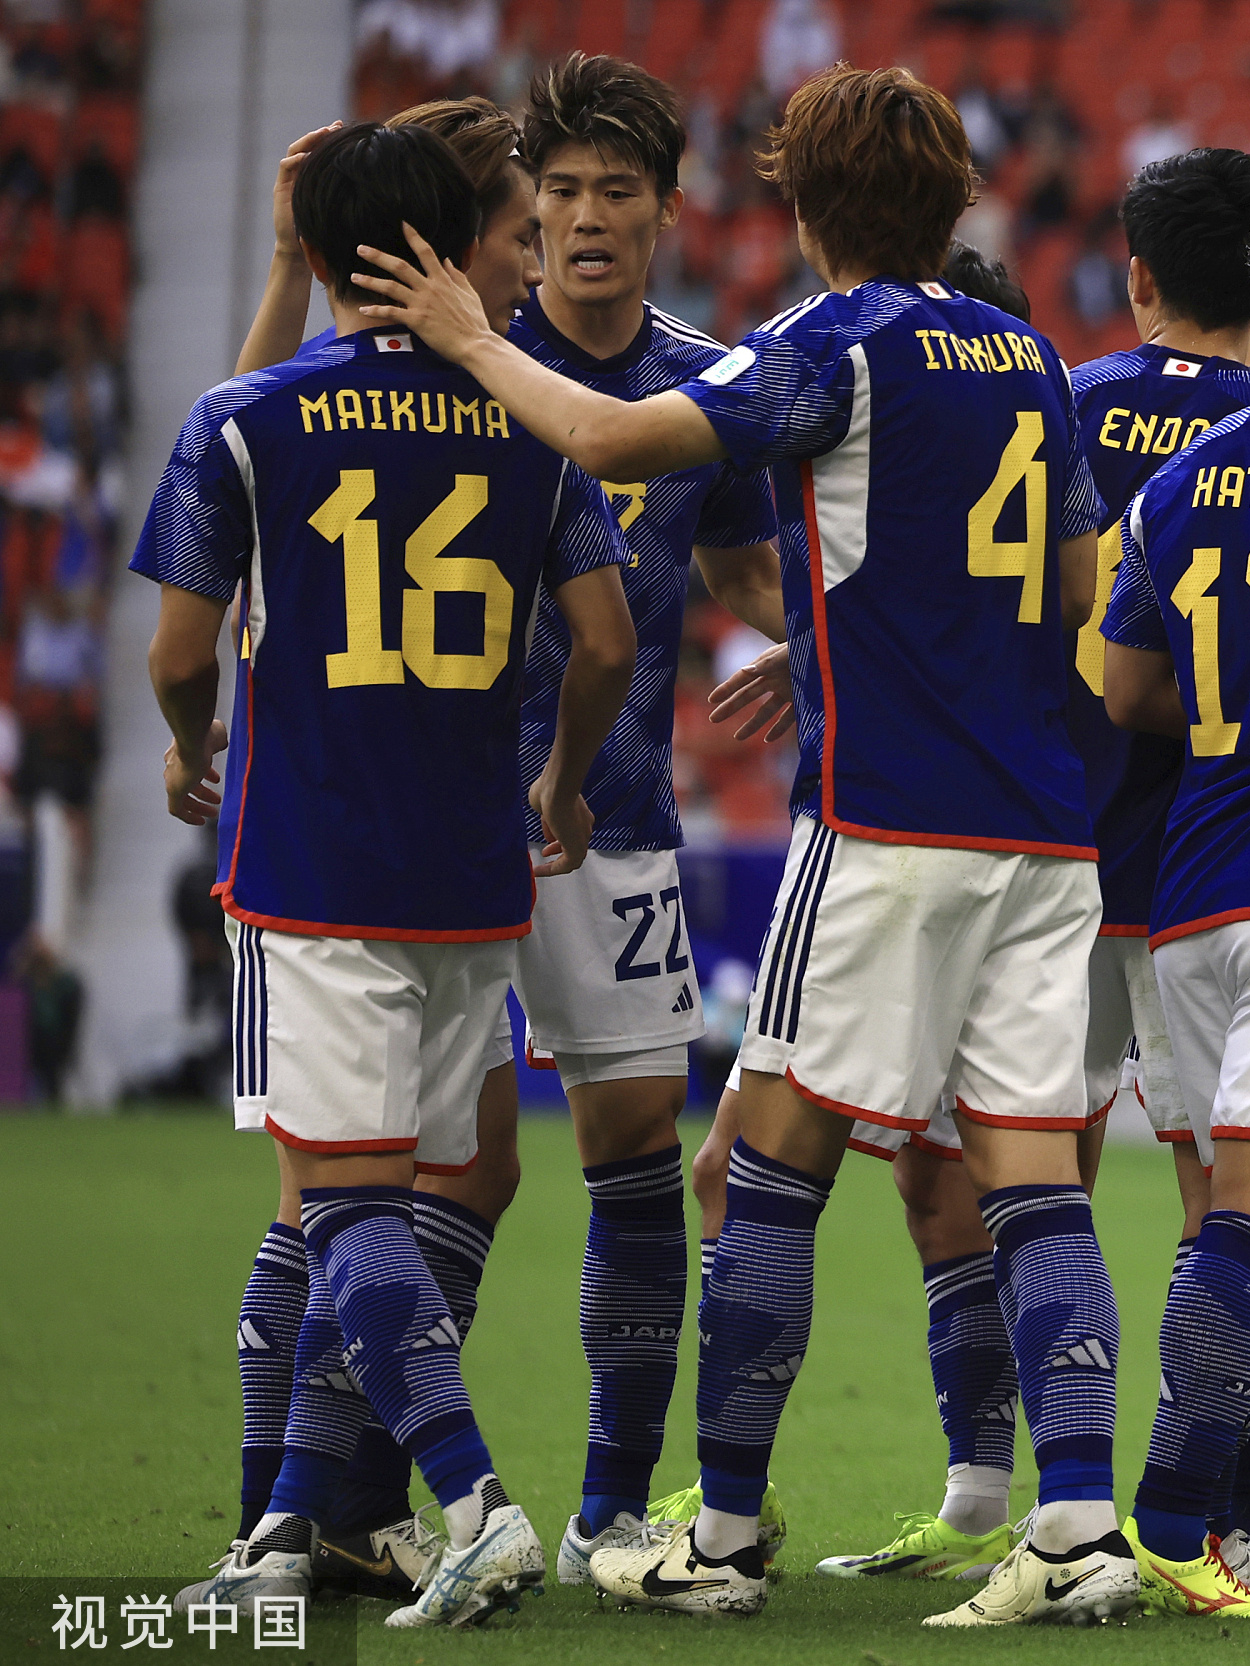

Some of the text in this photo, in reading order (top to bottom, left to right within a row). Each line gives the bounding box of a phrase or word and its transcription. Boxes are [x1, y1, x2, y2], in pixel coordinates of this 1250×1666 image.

[915, 329, 1047, 376] ITAKURA
[298, 389, 510, 439] MAIKUMA
[967, 411, 1047, 624] 4
[307, 469, 514, 690] 16
[612, 886, 689, 982] 22
[611, 1325, 683, 1340] JAP
